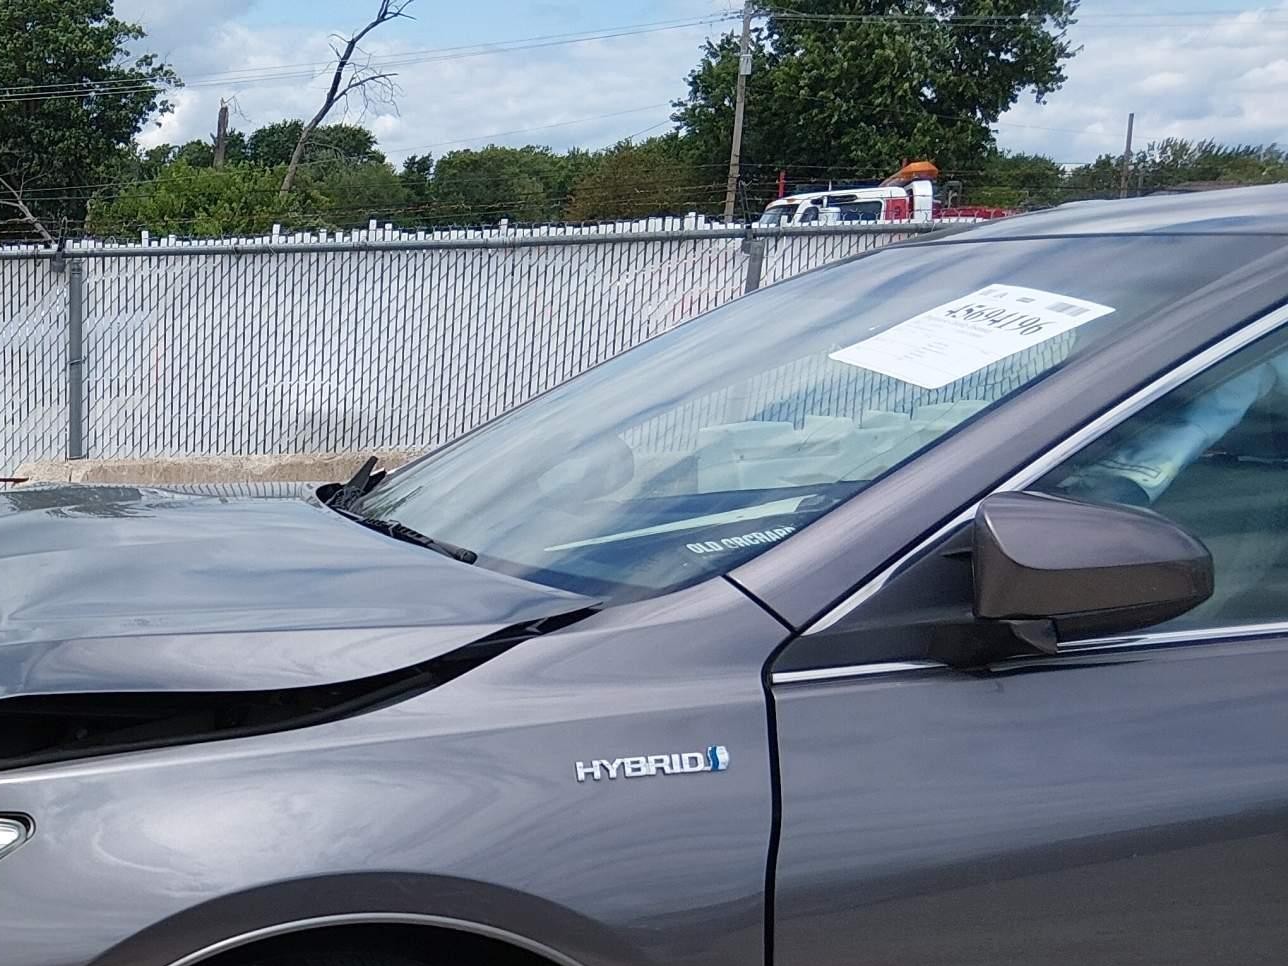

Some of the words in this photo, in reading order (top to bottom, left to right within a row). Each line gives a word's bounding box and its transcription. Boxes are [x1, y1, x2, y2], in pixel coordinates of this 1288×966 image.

[944, 303, 1057, 336] 45694196
[686, 541, 722, 553] OLD
[575, 752, 706, 782] HYBRID
